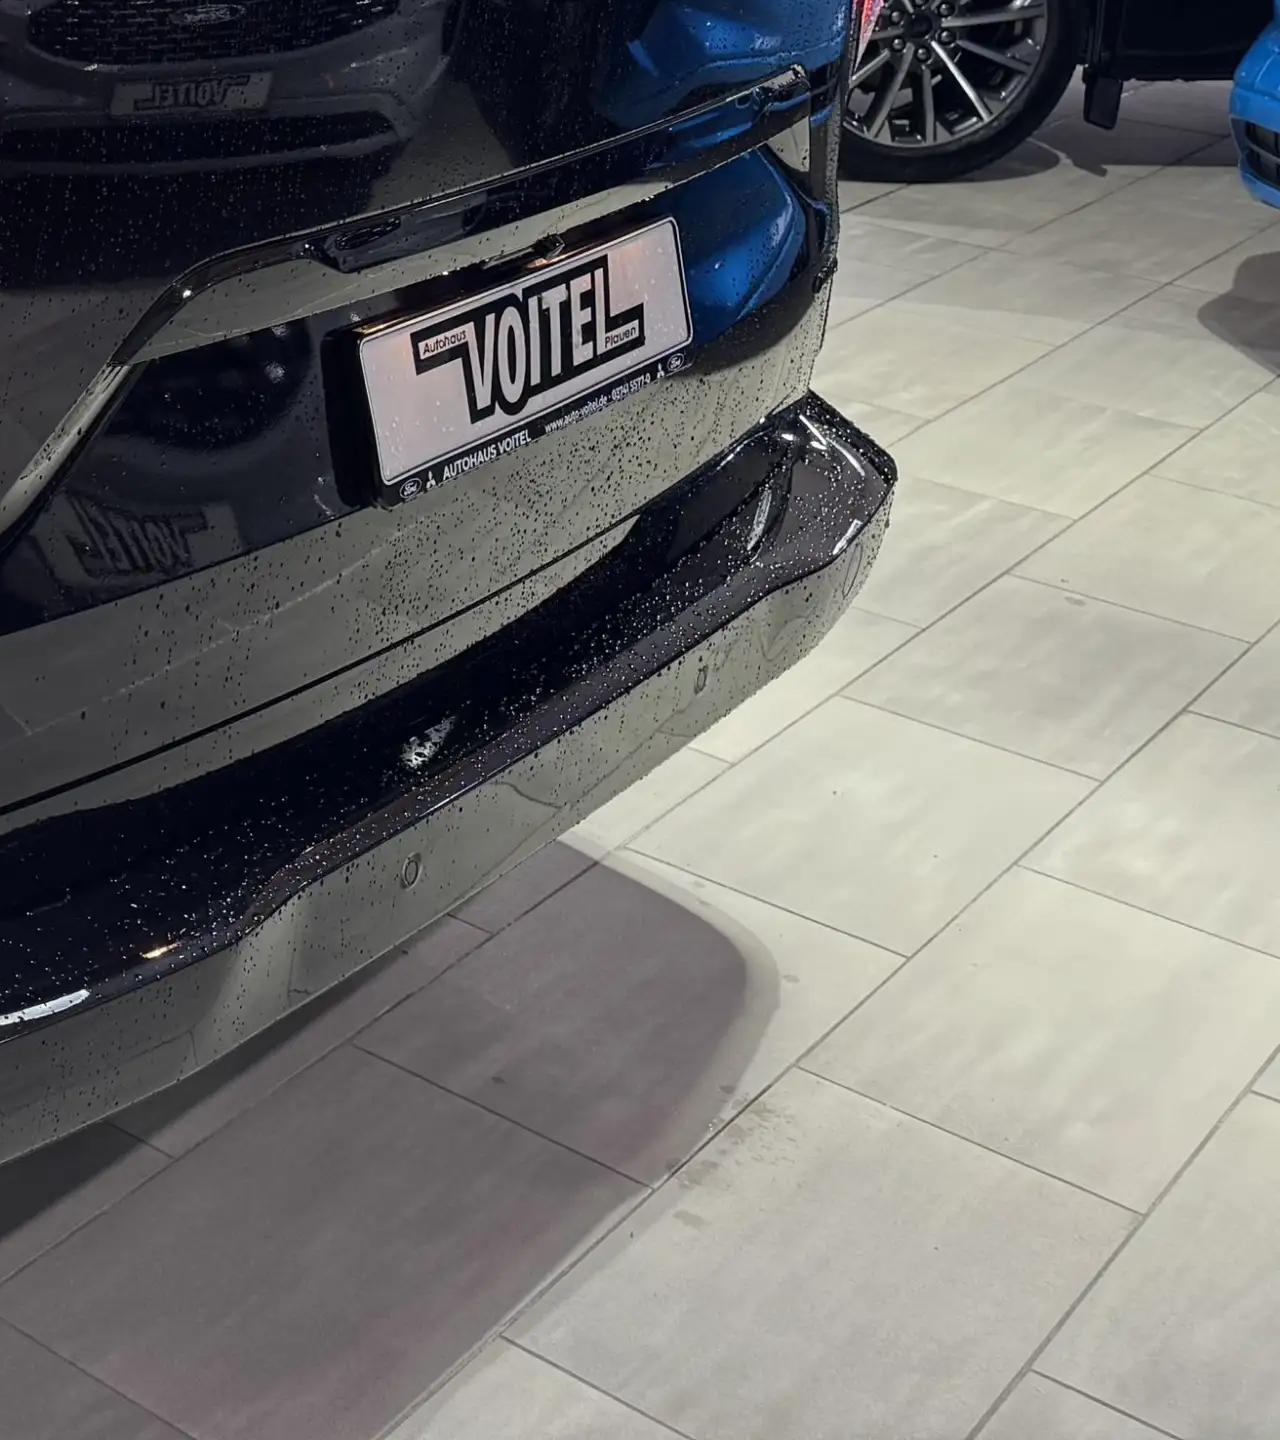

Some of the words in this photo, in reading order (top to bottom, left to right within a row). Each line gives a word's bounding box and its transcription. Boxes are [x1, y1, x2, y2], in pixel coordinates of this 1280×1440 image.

[422, 329, 467, 357] Autohaus
[465, 265, 608, 412] VOITEL
[604, 325, 637, 349] Plauen
[544, 394, 608, 434] www.auto-voitel.de
[442, 445, 498, 481] AUTOHAUS
[497, 429, 532, 453] VOITEL
